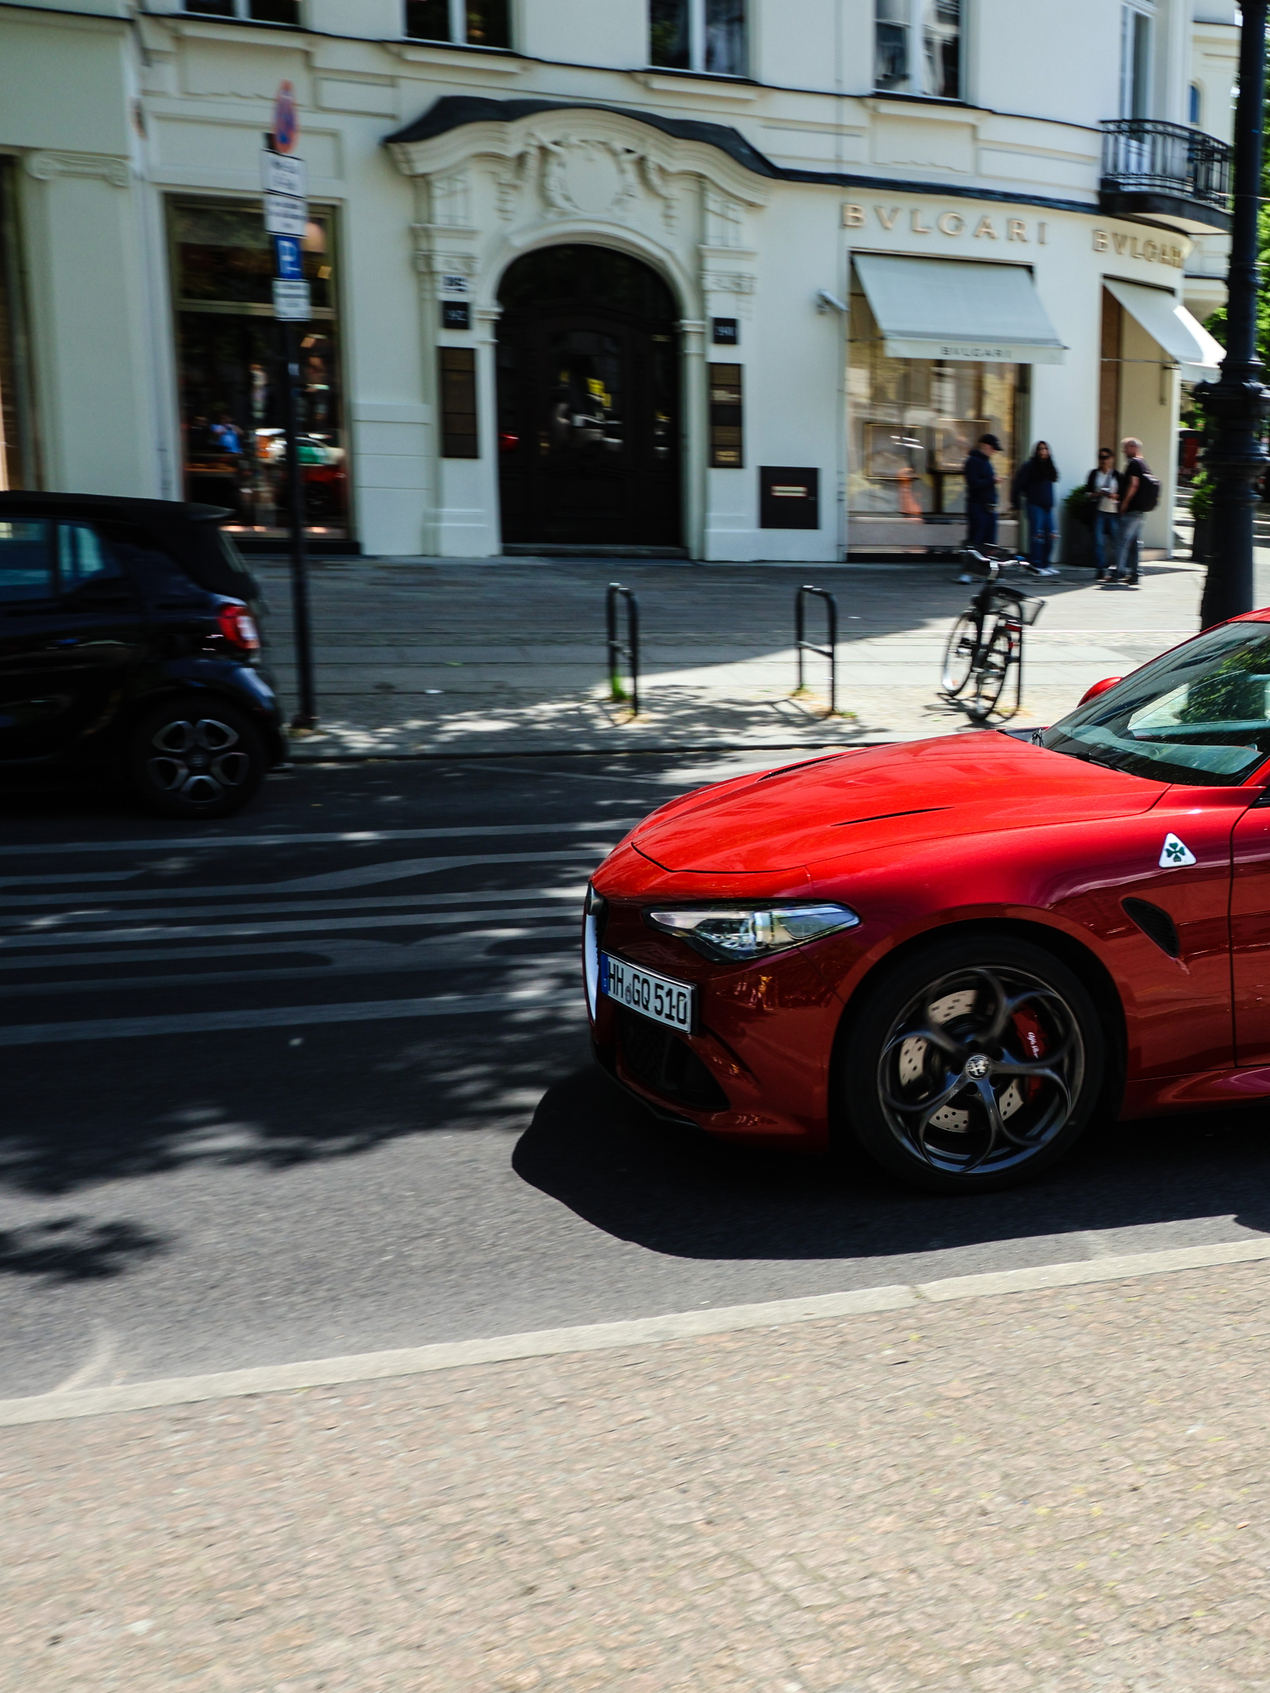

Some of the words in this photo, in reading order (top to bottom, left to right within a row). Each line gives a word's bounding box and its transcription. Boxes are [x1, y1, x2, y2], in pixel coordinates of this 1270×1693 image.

[841, 203, 1048, 245] BVLGARI
[608, 961, 625, 999] HH
[632, 973, 651, 1012] GQ
[654, 982, 687, 1025] 510
